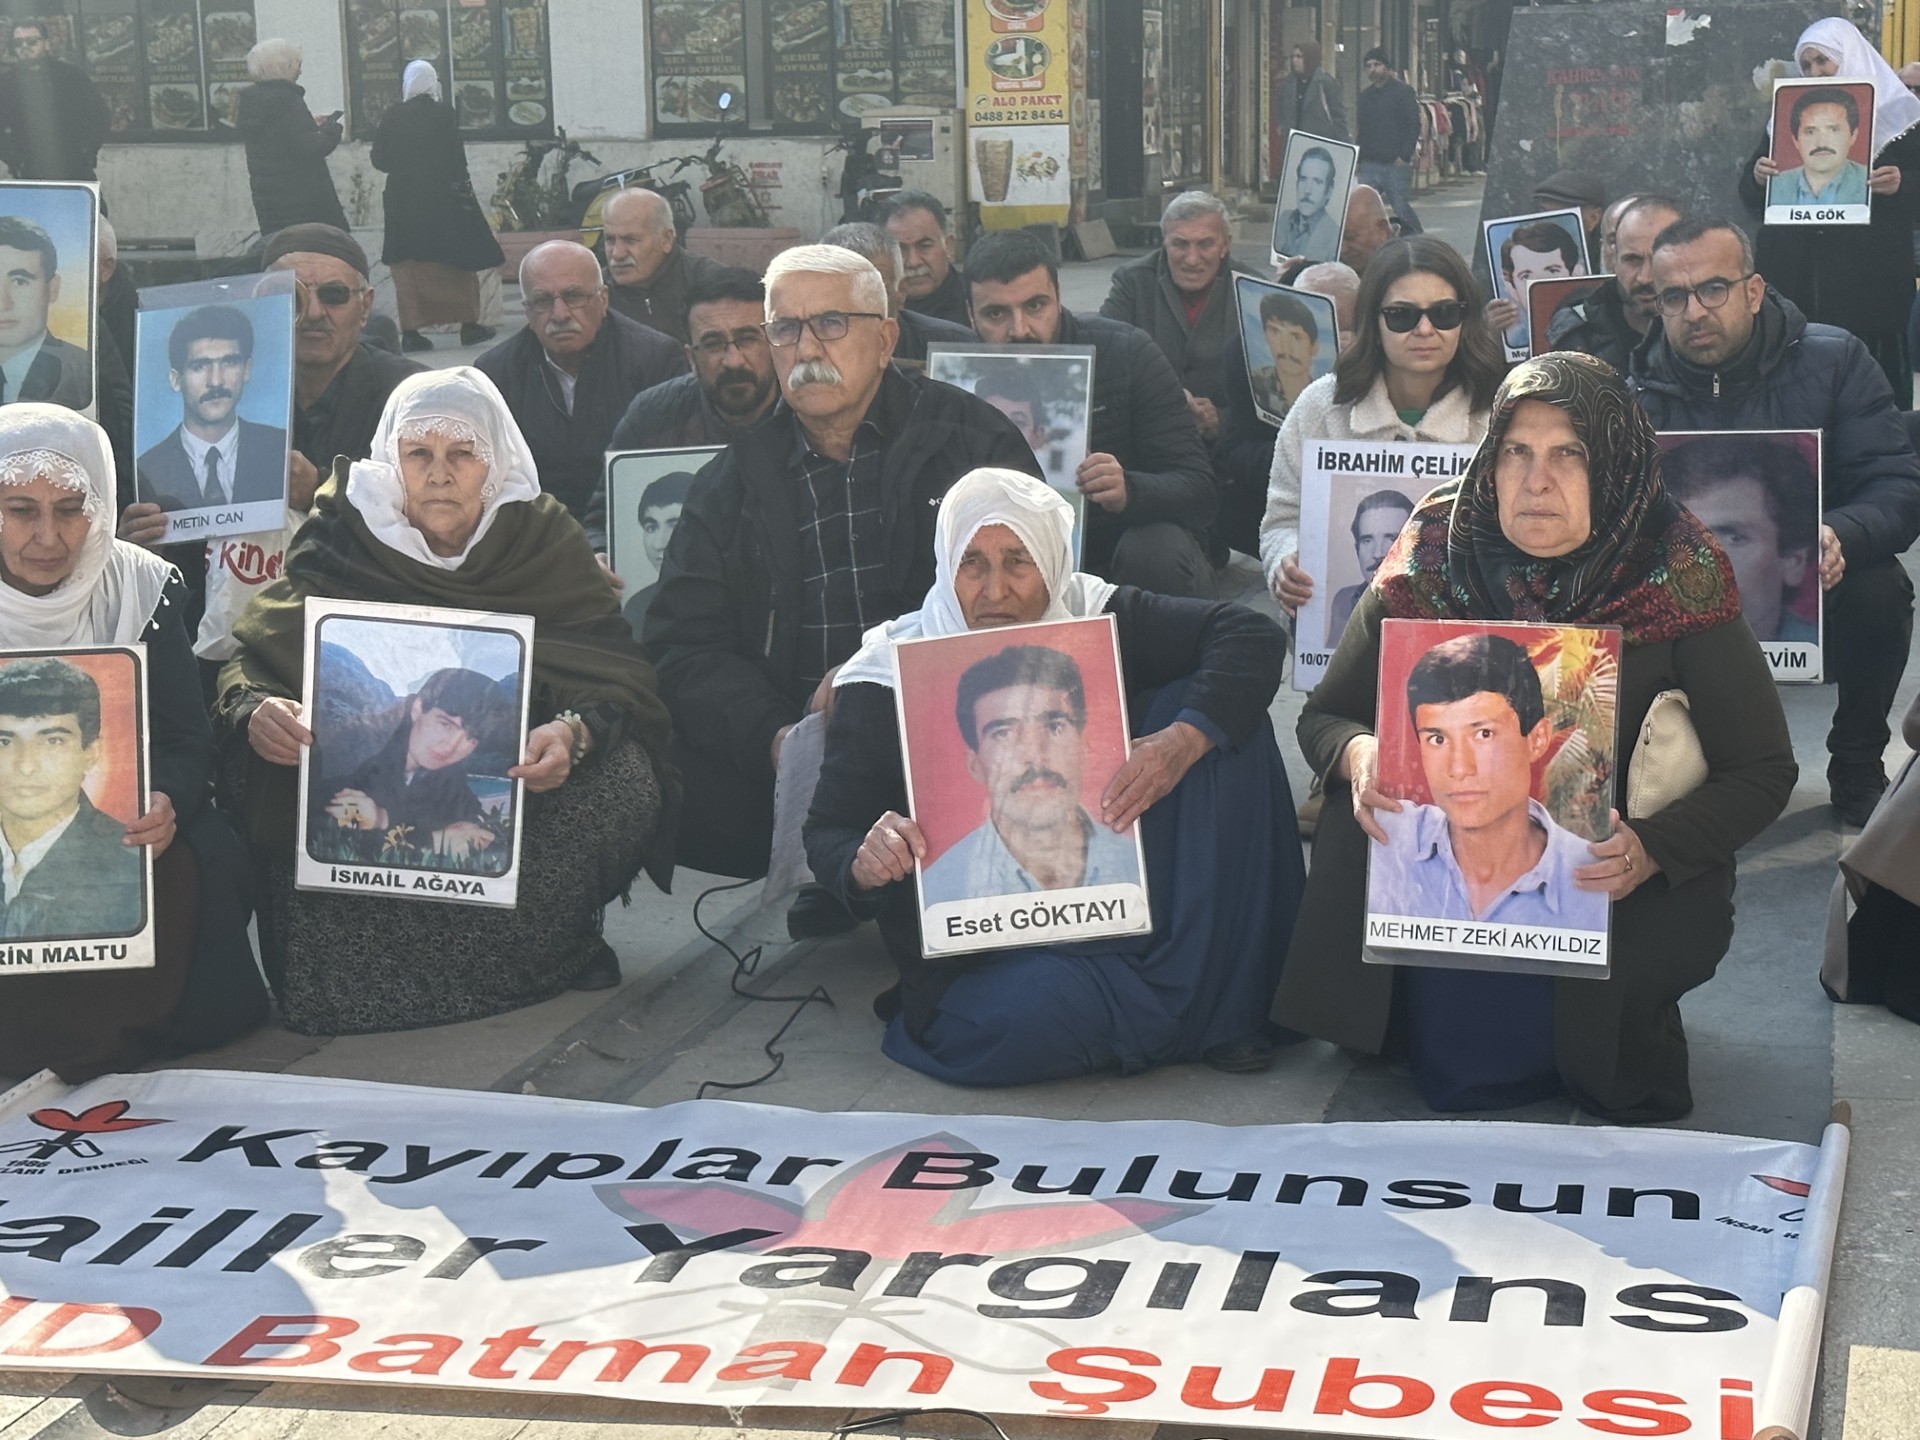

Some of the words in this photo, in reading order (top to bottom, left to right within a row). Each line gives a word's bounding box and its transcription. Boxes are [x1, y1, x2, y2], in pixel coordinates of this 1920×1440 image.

[993, 96, 1016, 106] ALO
[1021, 95, 1062, 106] PAKET
[975, 111, 1003, 121] 0488
[1007, 110, 1028, 120] 212
[1031, 110, 1046, 120] 84
[1049, 109, 1064, 119] 64
[1790, 208, 1811, 220] İSA
[1816, 208, 1845, 220] GÖK
[1511, 350, 1529, 358] Me
[1317, 446, 1404, 474] İBRAHİM
[1411, 452, 1472, 479] ÇELİK
[173, 513, 209, 530] METİN
[216, 511, 244, 525] CAN
[1300, 652, 1330, 666] 10/07
[1763, 647, 1806, 668] VİM
[331, 866, 405, 887] İSMAİL
[413, 874, 485, 896] AĞAYA
[946, 912, 1003, 937] Eset
[1010, 899, 1126, 930] GÖKTAYI
[1370, 921, 1457, 943] MEHMET
[1462, 928, 1507, 947] ZEKİ
[1511, 932, 1601, 955] AKYILDIZ
[42, 944, 127, 963] MALTU
[0, 1167, 46, 1175] LARI
[178, 1125, 843, 1190] Kayıplar
[882, 1150, 1700, 1220] Bulunsun
[0, 1198, 547, 1280] ailler
[624, 1223, 1784, 1333] Yargılans
[200, 1315, 956, 1394] Batman
[1028, 1345, 1756, 1440] Şubesi
